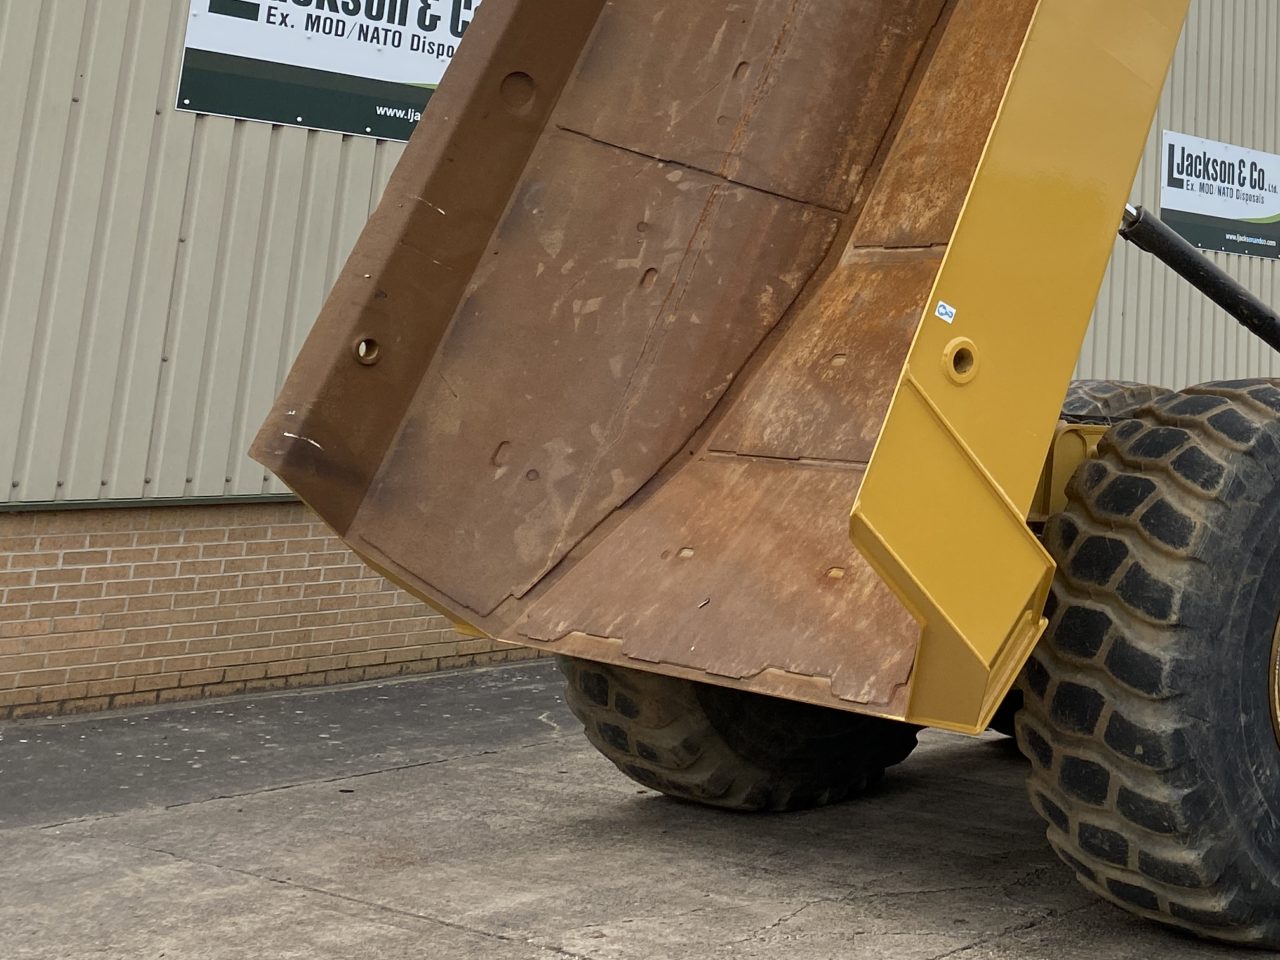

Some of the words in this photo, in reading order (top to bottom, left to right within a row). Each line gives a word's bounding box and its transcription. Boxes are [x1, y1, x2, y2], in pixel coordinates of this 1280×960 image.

[266, 6, 295, 29] Ex.
[1238, 159, 1247, 187] &
[1250, 161, 1267, 192] Co.
[1236, 189, 1265, 205] Disposals
